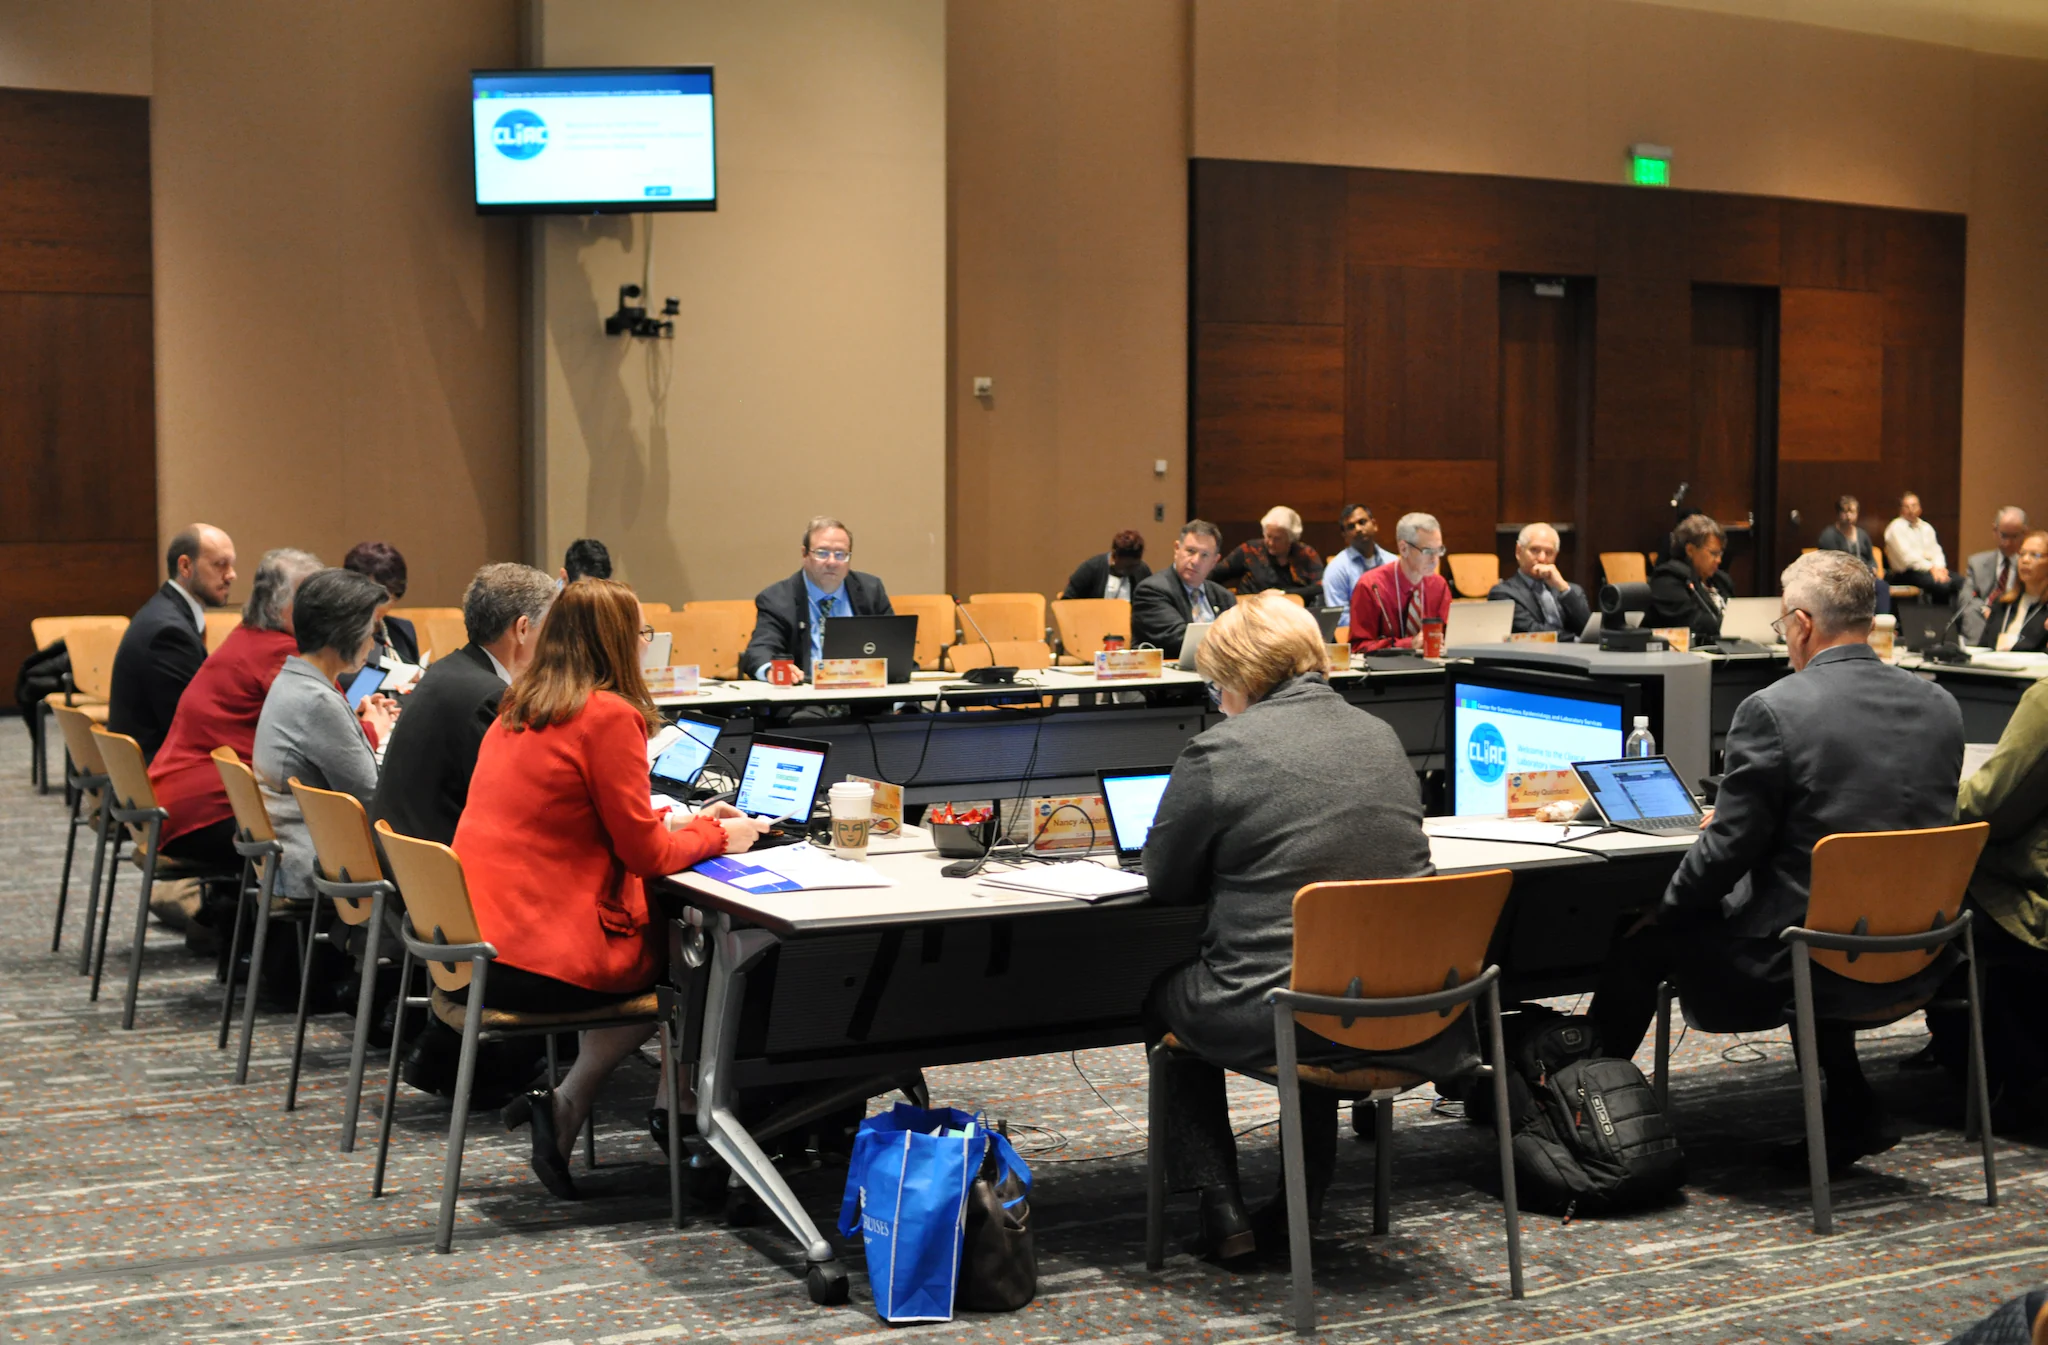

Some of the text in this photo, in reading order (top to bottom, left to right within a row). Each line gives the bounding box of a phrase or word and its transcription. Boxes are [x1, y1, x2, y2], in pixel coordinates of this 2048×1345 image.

[1518, 744, 1544, 755] Welcome
[1545, 748, 1552, 757] to
[1552, 749, 1563, 759] the
[1523, 789, 1540, 798] Andy
[1053, 818, 1077, 827] Nancy
